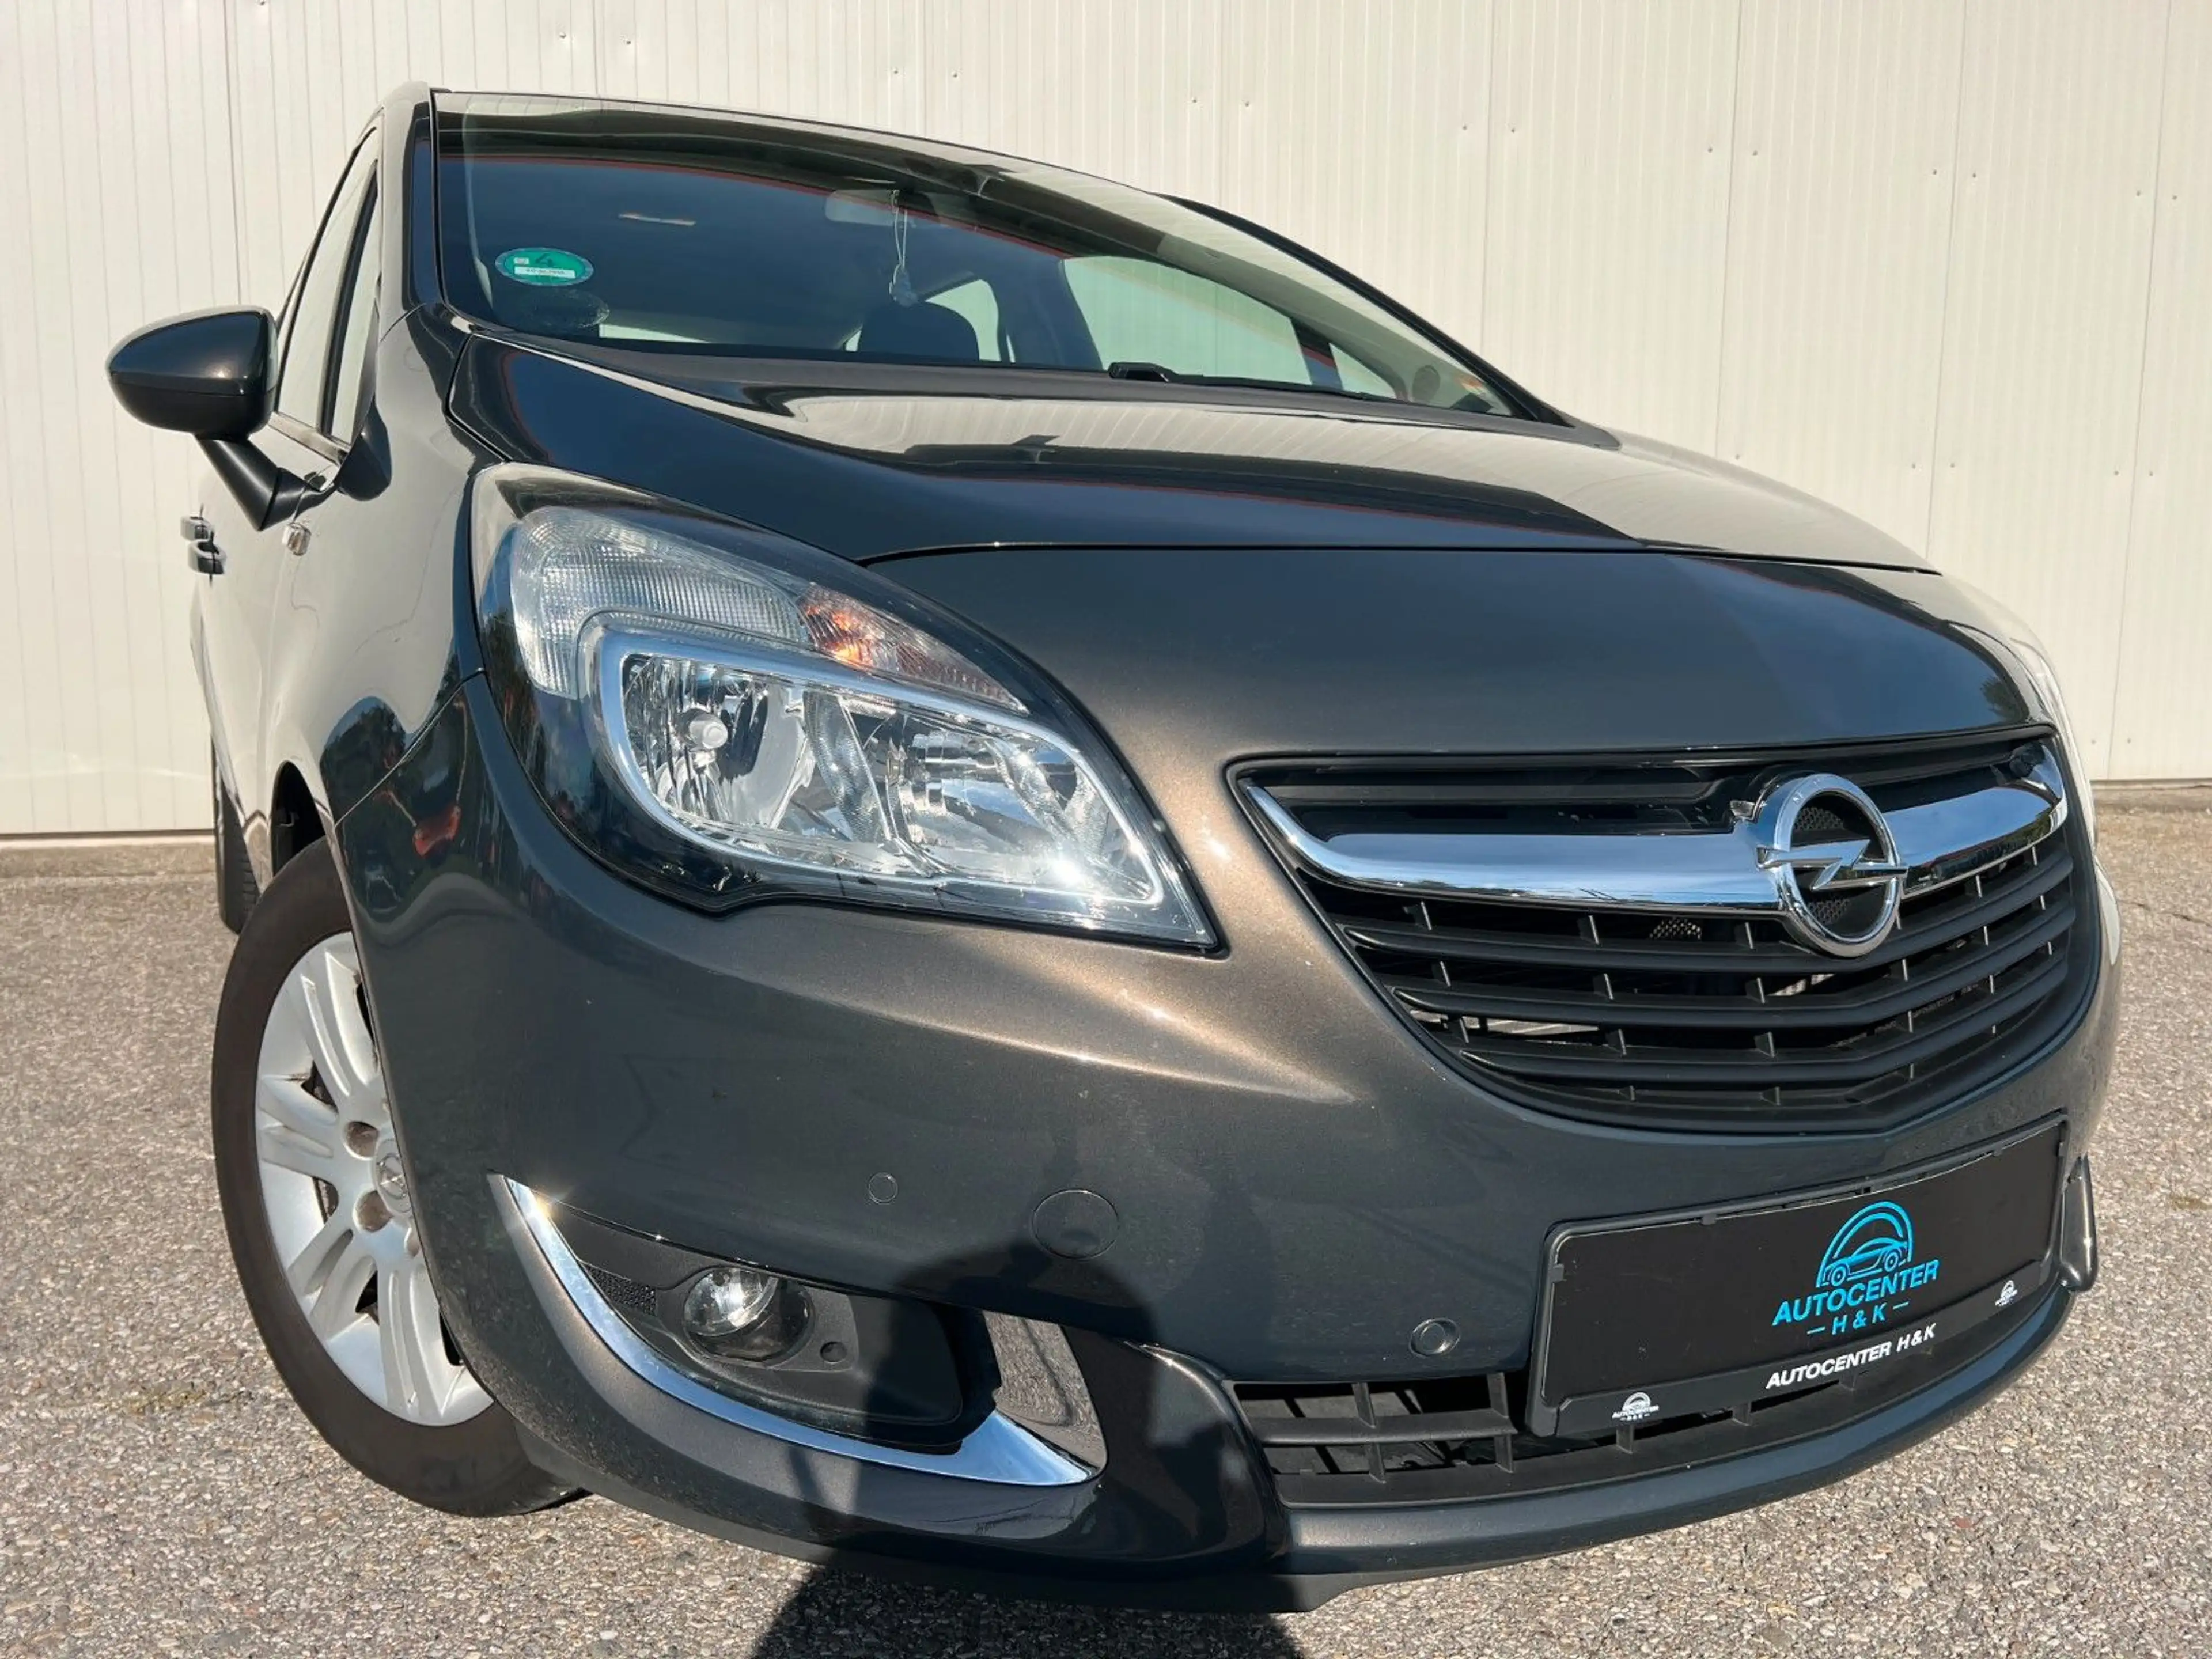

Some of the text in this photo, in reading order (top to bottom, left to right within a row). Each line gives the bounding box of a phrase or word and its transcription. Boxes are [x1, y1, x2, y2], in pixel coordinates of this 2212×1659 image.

[1772, 1259, 1940, 1326] AUTOCENTER
[1831, 1304, 1887, 1335] H & K
[1765, 1340, 1892, 1389] AUTOCENTER
